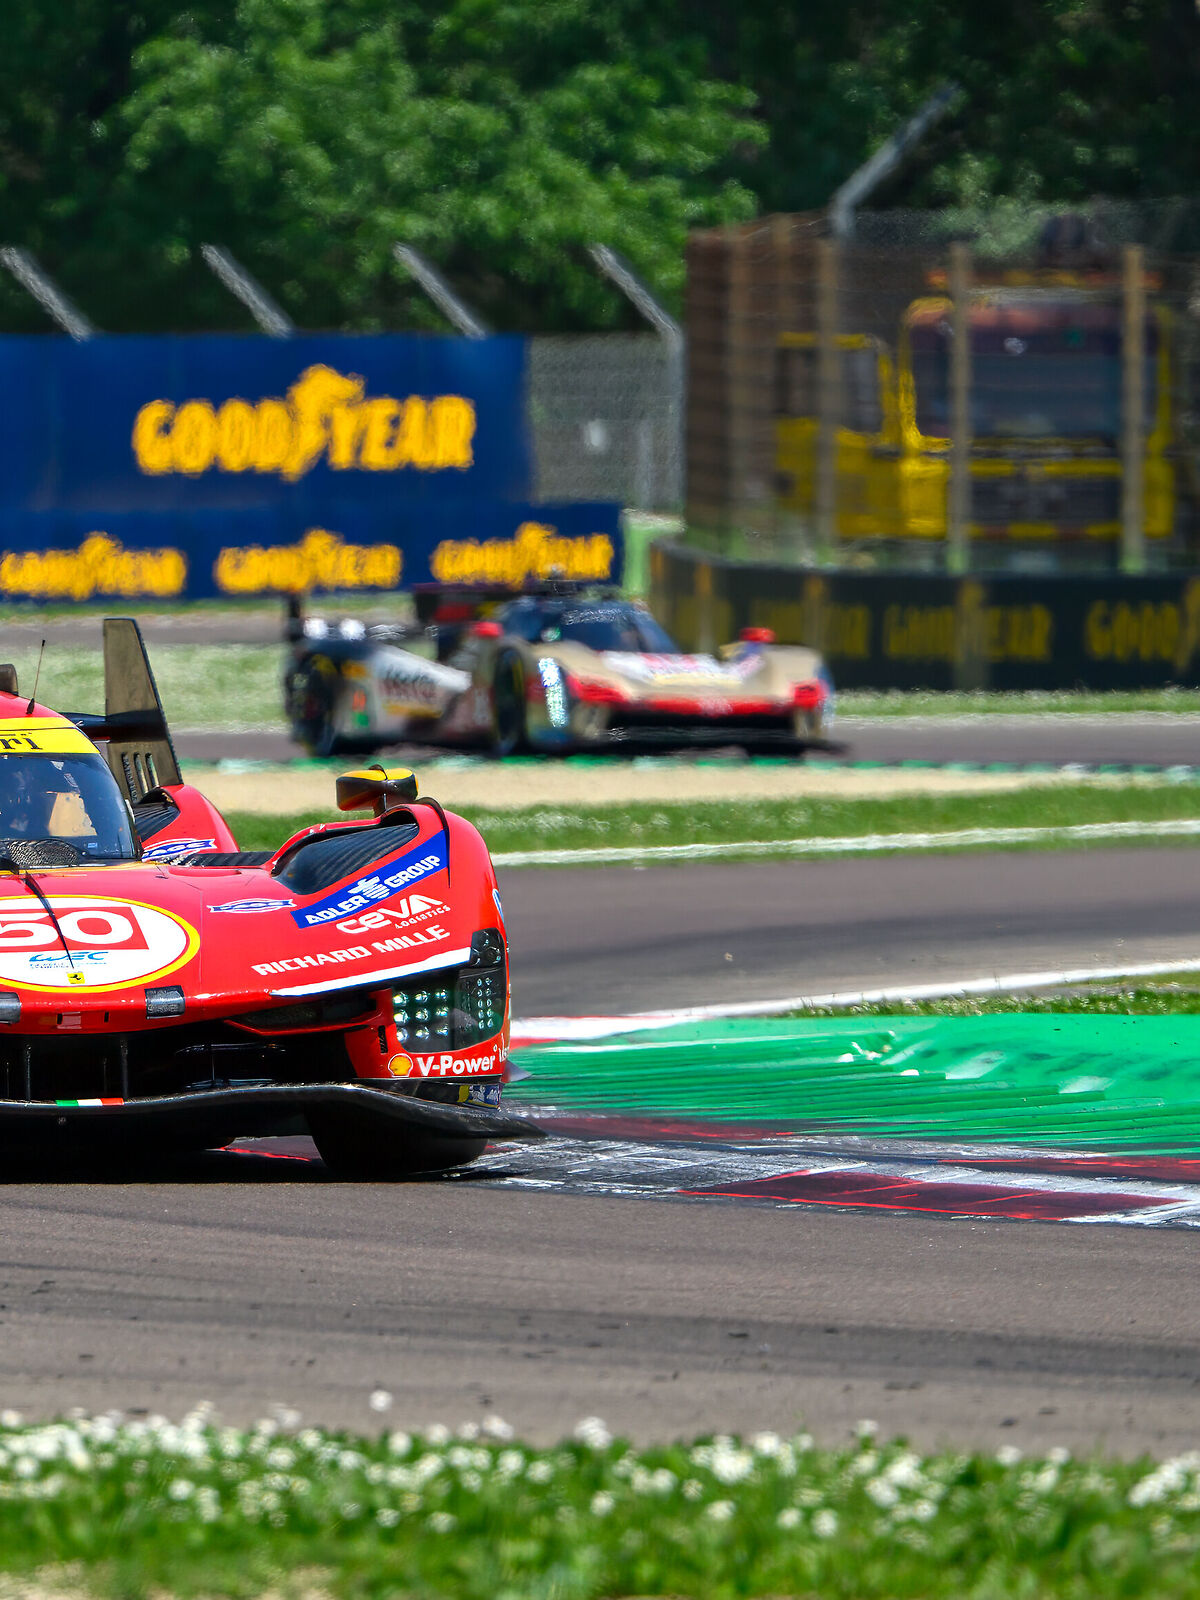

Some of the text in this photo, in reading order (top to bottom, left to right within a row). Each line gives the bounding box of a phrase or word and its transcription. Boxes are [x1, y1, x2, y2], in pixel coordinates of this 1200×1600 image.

[132, 365, 475, 476] GOODYEAR
[304, 895, 370, 924] ADLER
[383, 854, 441, 888] GROUP
[250, 924, 451, 976] RICHARD MILLE
[415, 1055, 496, 1077] V-Power
